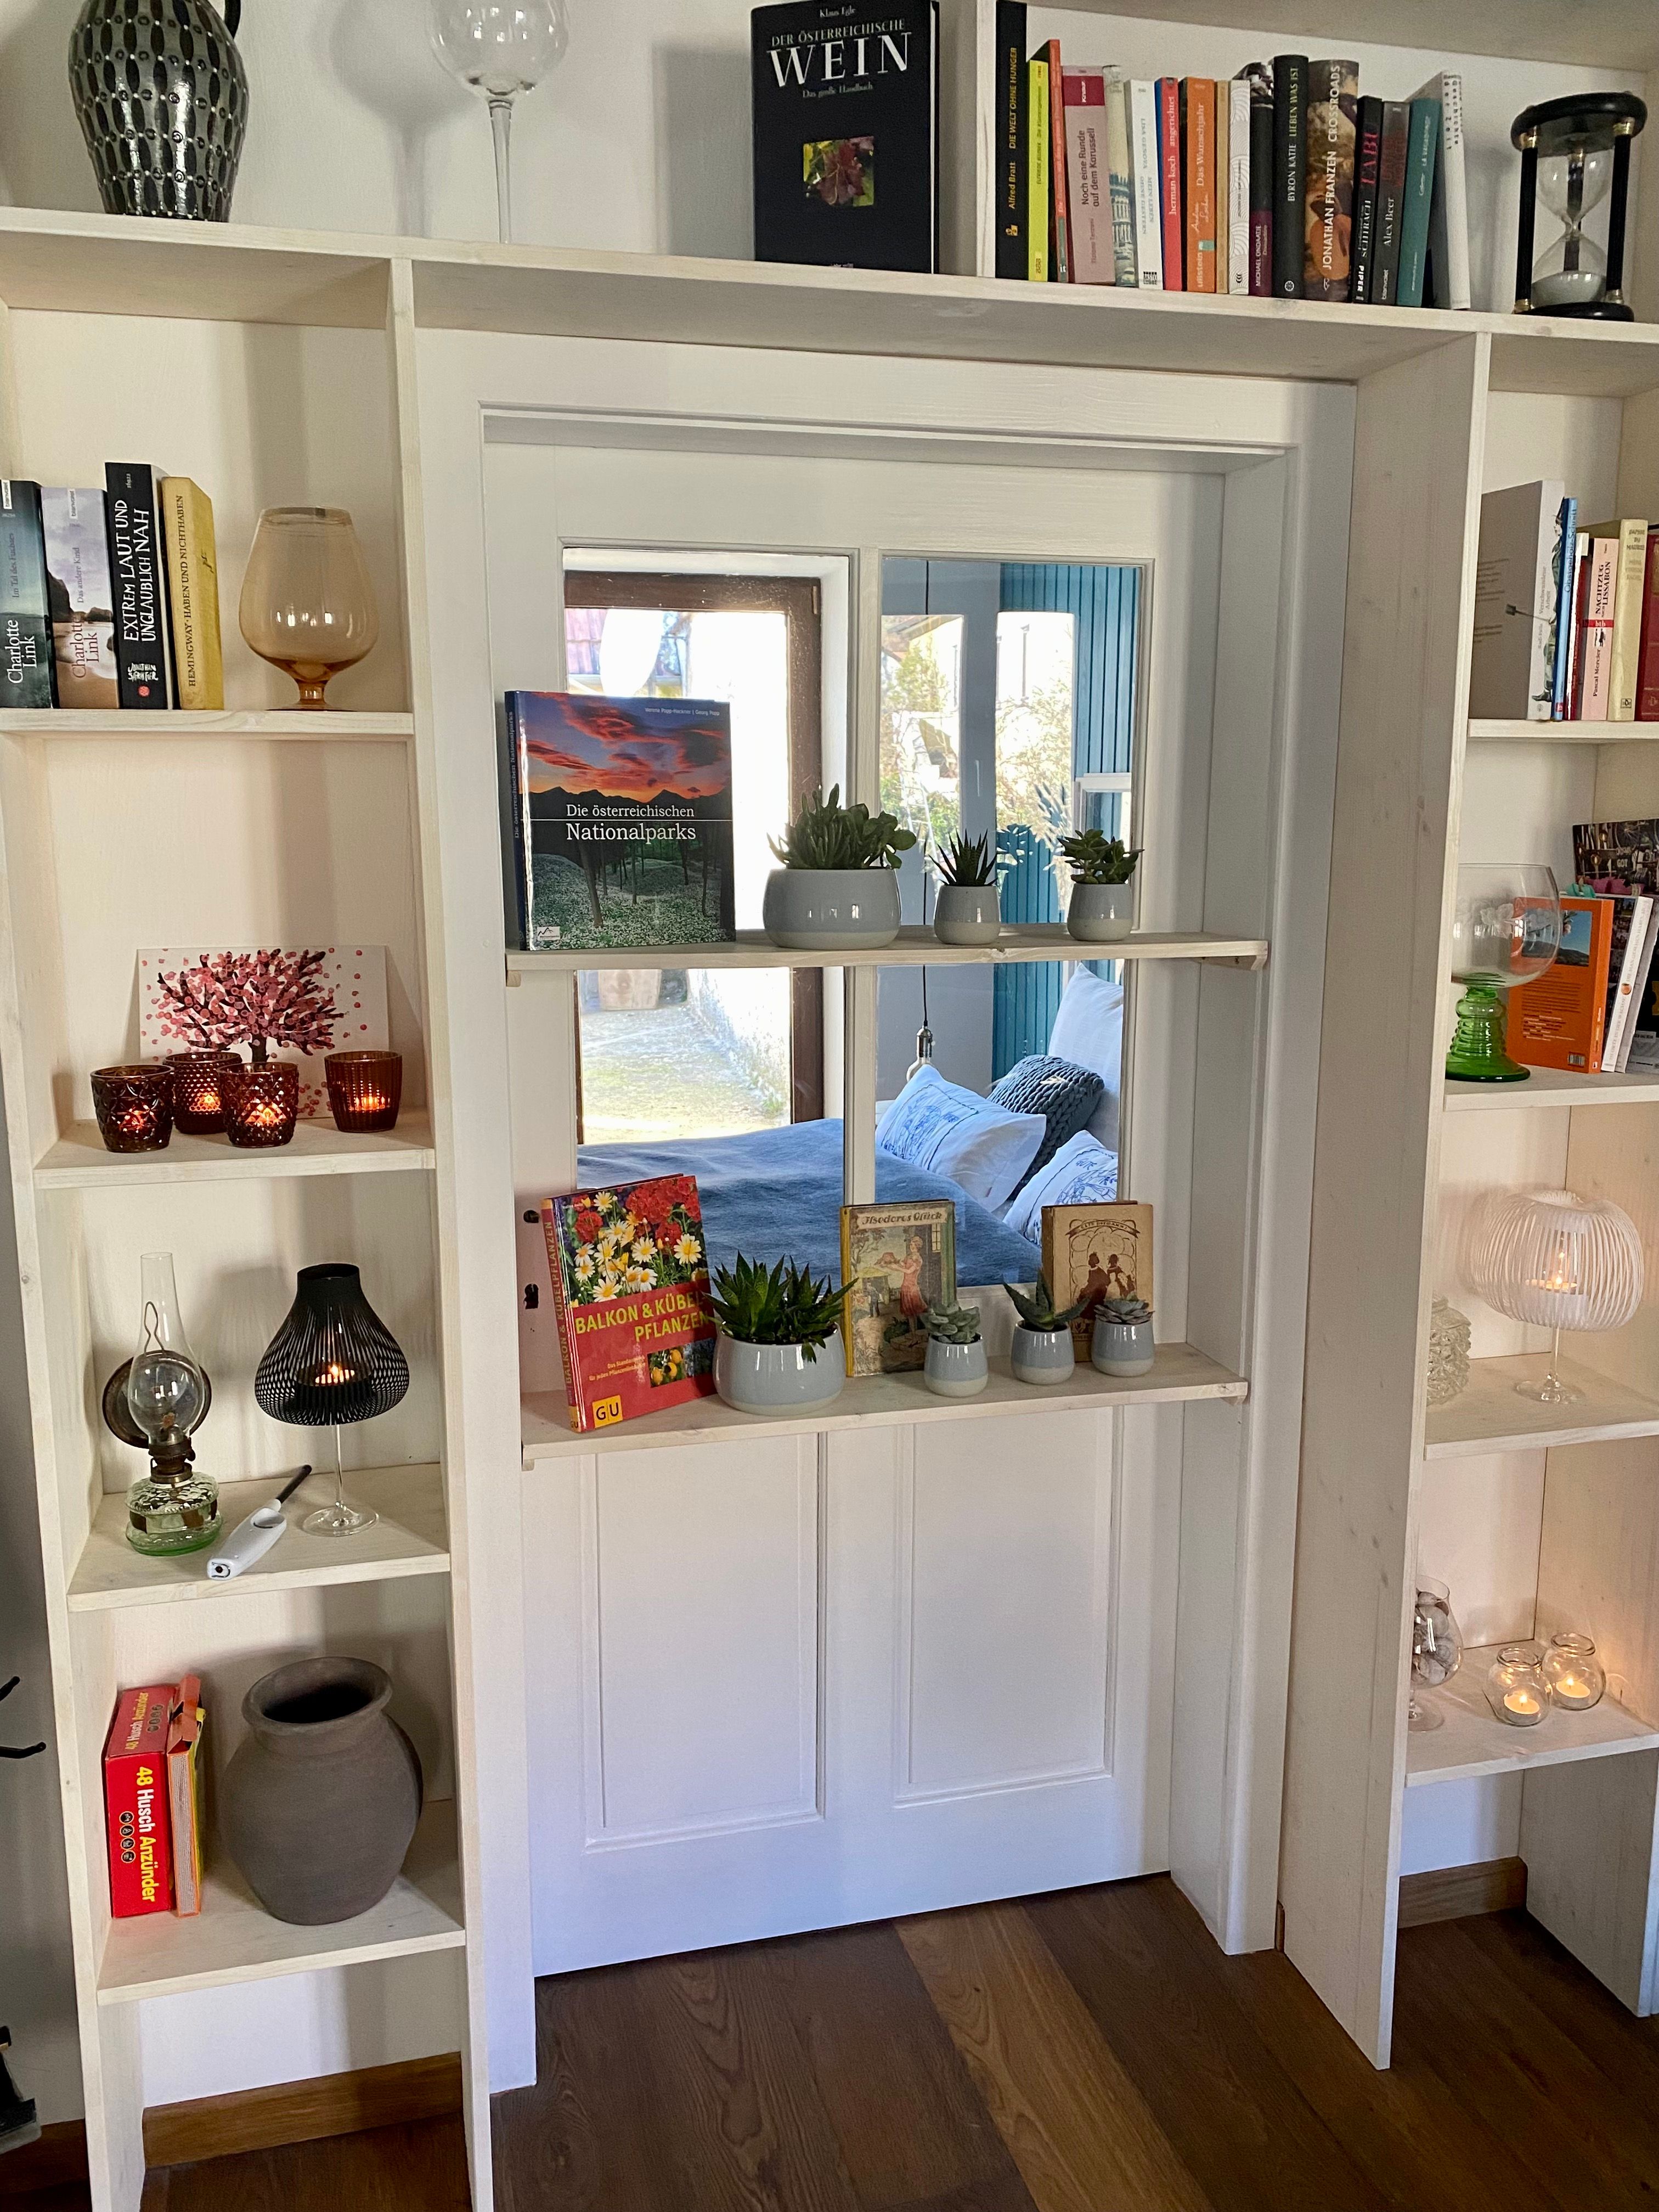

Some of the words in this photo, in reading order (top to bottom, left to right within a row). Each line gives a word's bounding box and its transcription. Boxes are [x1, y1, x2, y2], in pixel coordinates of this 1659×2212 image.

[772, 34, 793, 47] DER
[798, 19, 905, 43] ÖSTERREICHISCHE
[766, 32, 912, 87] WEIN
[1290, 67, 1299, 80] IST
[1328, 65, 1340, 143] CROSSROADS
[1289, 106, 1297, 137] LIEBEN
[1077, 130, 1086, 159] Runde
[1087, 128, 1097, 168] Karussell
[1288, 143, 1296, 167] KATIE
[1287, 171, 1296, 202] BYRON
[1325, 151, 1336, 204] FRANZEN
[1081, 183, 1089, 205] Noch
[1091, 193, 1099, 207] auf
[1385, 198, 1395, 221] Beer
[1323, 207, 1335, 270] JONATHAN
[1384, 224, 1392, 246] Alex
[114, 500, 128, 528] UND
[176, 495, 188, 560] NICHTHABEN
[133, 508, 150, 553] NAH
[72, 548, 80, 564] Kind
[116, 532, 136, 579] LAUT
[75, 566, 83, 589] andere
[180, 562, 190, 585] UND
[1595, 564, 1604, 614] NACHTZUG
[121, 583, 139, 641] EXTREM
[138, 556, 156, 642] UNGLAUBLICH
[182, 585, 192, 619] HABEN
[4, 619, 24, 684] Charlotte
[19, 634, 37, 668] Link
[70, 614, 87, 678] Charlotte
[83, 632, 99, 663] Link
[185, 622, 196, 687] HEMINGWAY
[566, 804, 589, 816] Die
[592, 804, 695, 817] österreichischen
[566, 823, 696, 845] Nationalparks
[575, 1305, 639, 1334] BALKON
[642, 1303, 654, 1318] &
[634, 1310, 709, 1342] PFLANZEN
[561, 1338, 572, 1384] BALKON
[126, 1720, 143, 1741] Husch
[136, 1767, 154, 1786] 48
[137, 1788, 156, 1833] Husch
[139, 1836, 160, 1903] Anzünder
